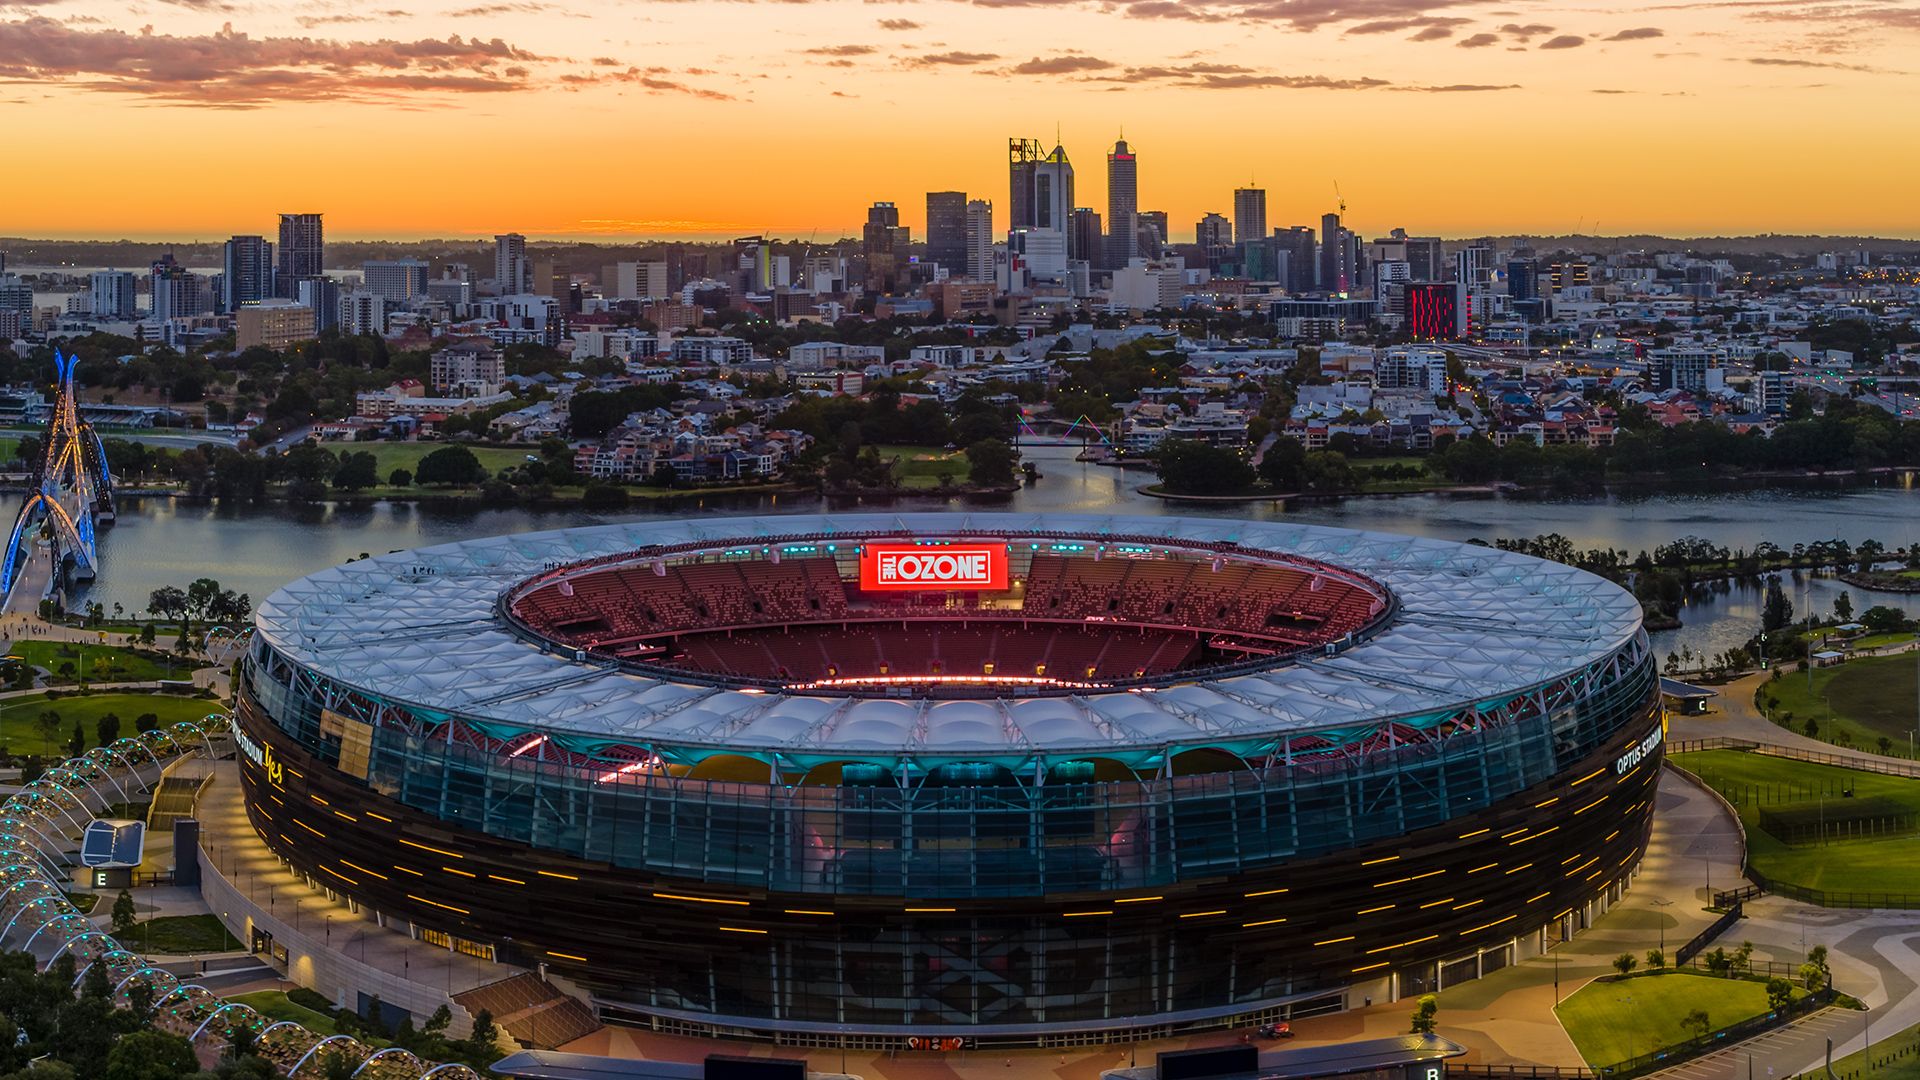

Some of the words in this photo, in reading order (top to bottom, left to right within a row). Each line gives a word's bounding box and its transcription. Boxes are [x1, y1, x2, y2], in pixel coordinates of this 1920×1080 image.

[882, 556, 897, 580] THE
[897, 555, 987, 580] OZONE
[1699, 701, 1705, 710] C
[241, 733, 263, 766] STADIUM
[1617, 746, 1640, 774] OPTUS
[1642, 725, 1662, 757] STADIUM
[97, 873, 106, 886] E
